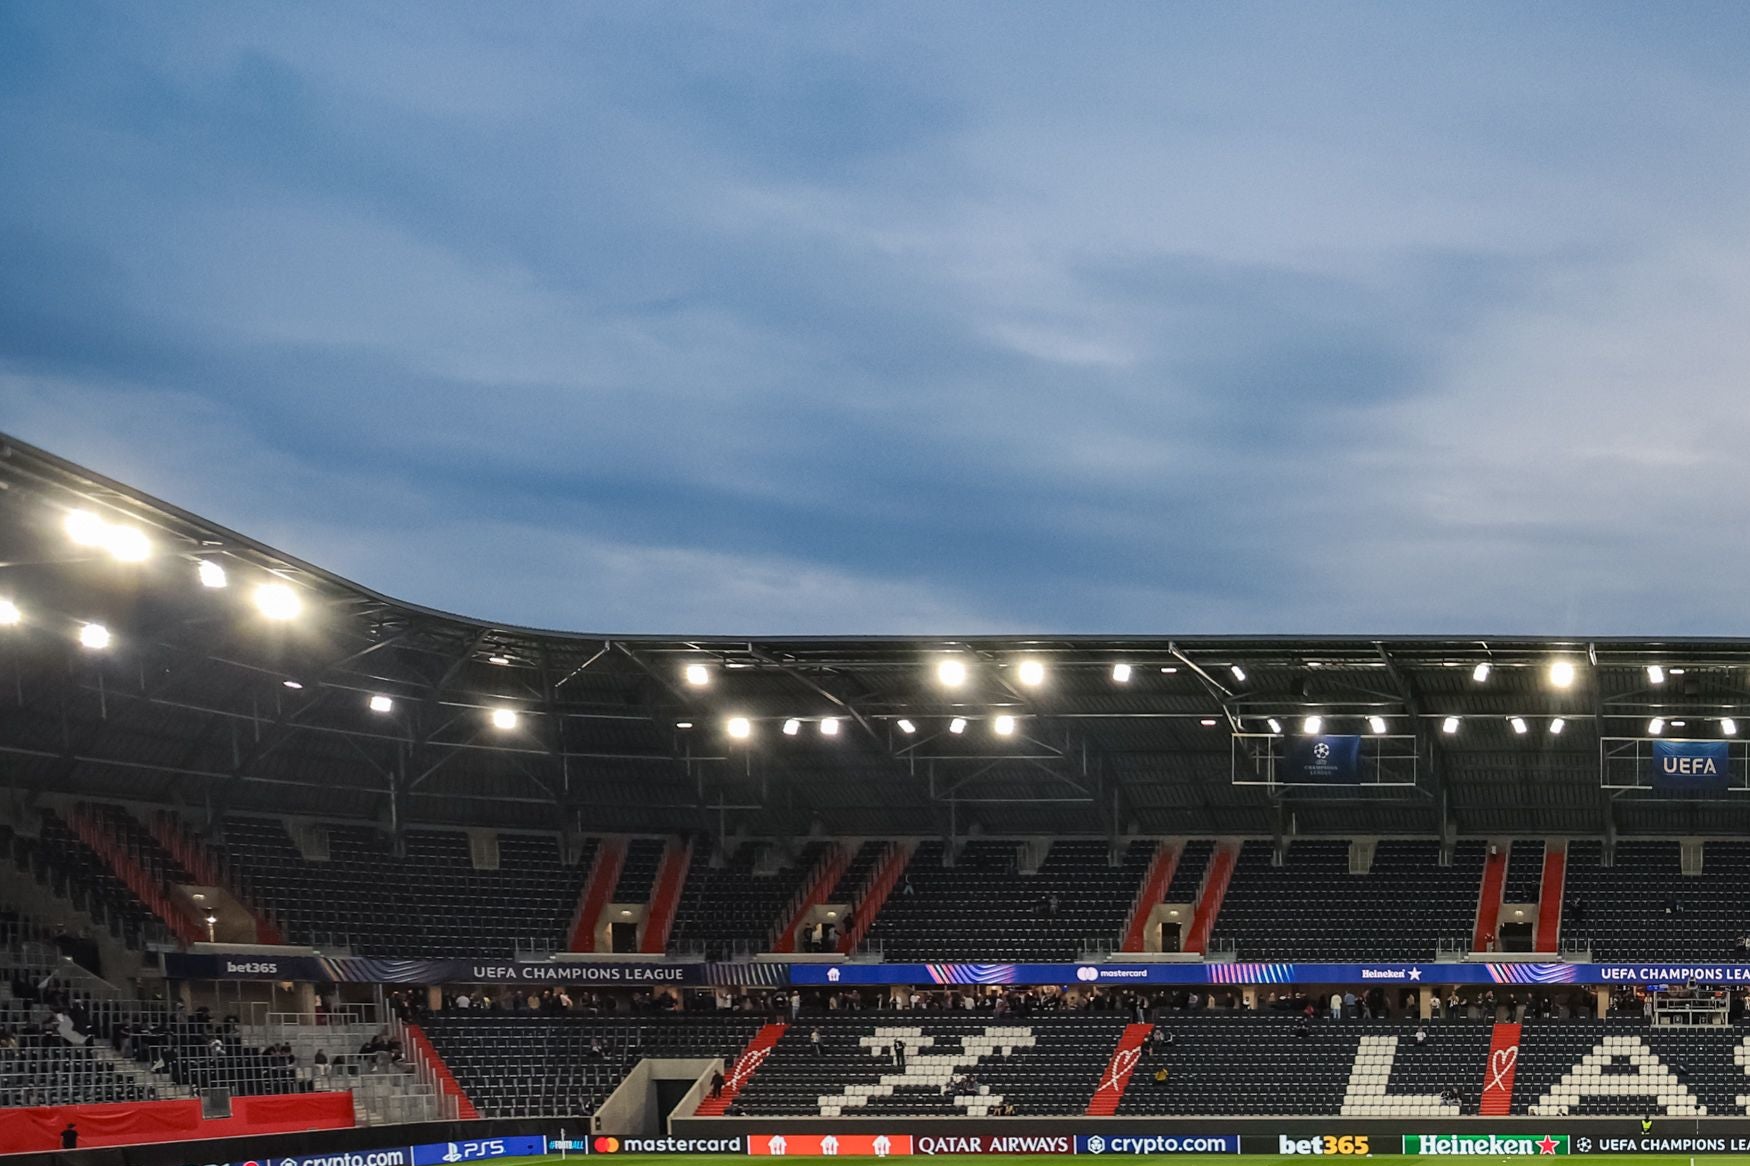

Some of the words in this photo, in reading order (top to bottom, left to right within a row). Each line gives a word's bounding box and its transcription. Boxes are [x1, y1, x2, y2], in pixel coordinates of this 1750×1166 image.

[1663, 757, 1717, 774] UEFA
[227, 961, 278, 973] bet365
[473, 966, 517, 978] UEFA
[522, 967, 620, 980] CHAMPIONS
[625, 968, 684, 980] LEAGUE
[1100, 969, 1148, 978] mastercard
[1361, 969, 1404, 979] Heineken
[1601, 968, 1637, 980] UEFA
[1639, 968, 1723, 981] CHAMPIONS
[464, 1140, 505, 1158] PS5
[624, 1136, 741, 1152] mastercard
[918, 1137, 982, 1155] QATAR
[989, 1137, 1068, 1153] AIRWAYS
[1110, 1136, 1226, 1155] crypto.com
[1279, 1135, 1369, 1155] bet365
[1418, 1135, 1535, 1155] Heineken
[1599, 1138, 1637, 1151] UEFA
[1641, 1138, 1725, 1151] CHAMPIONS
